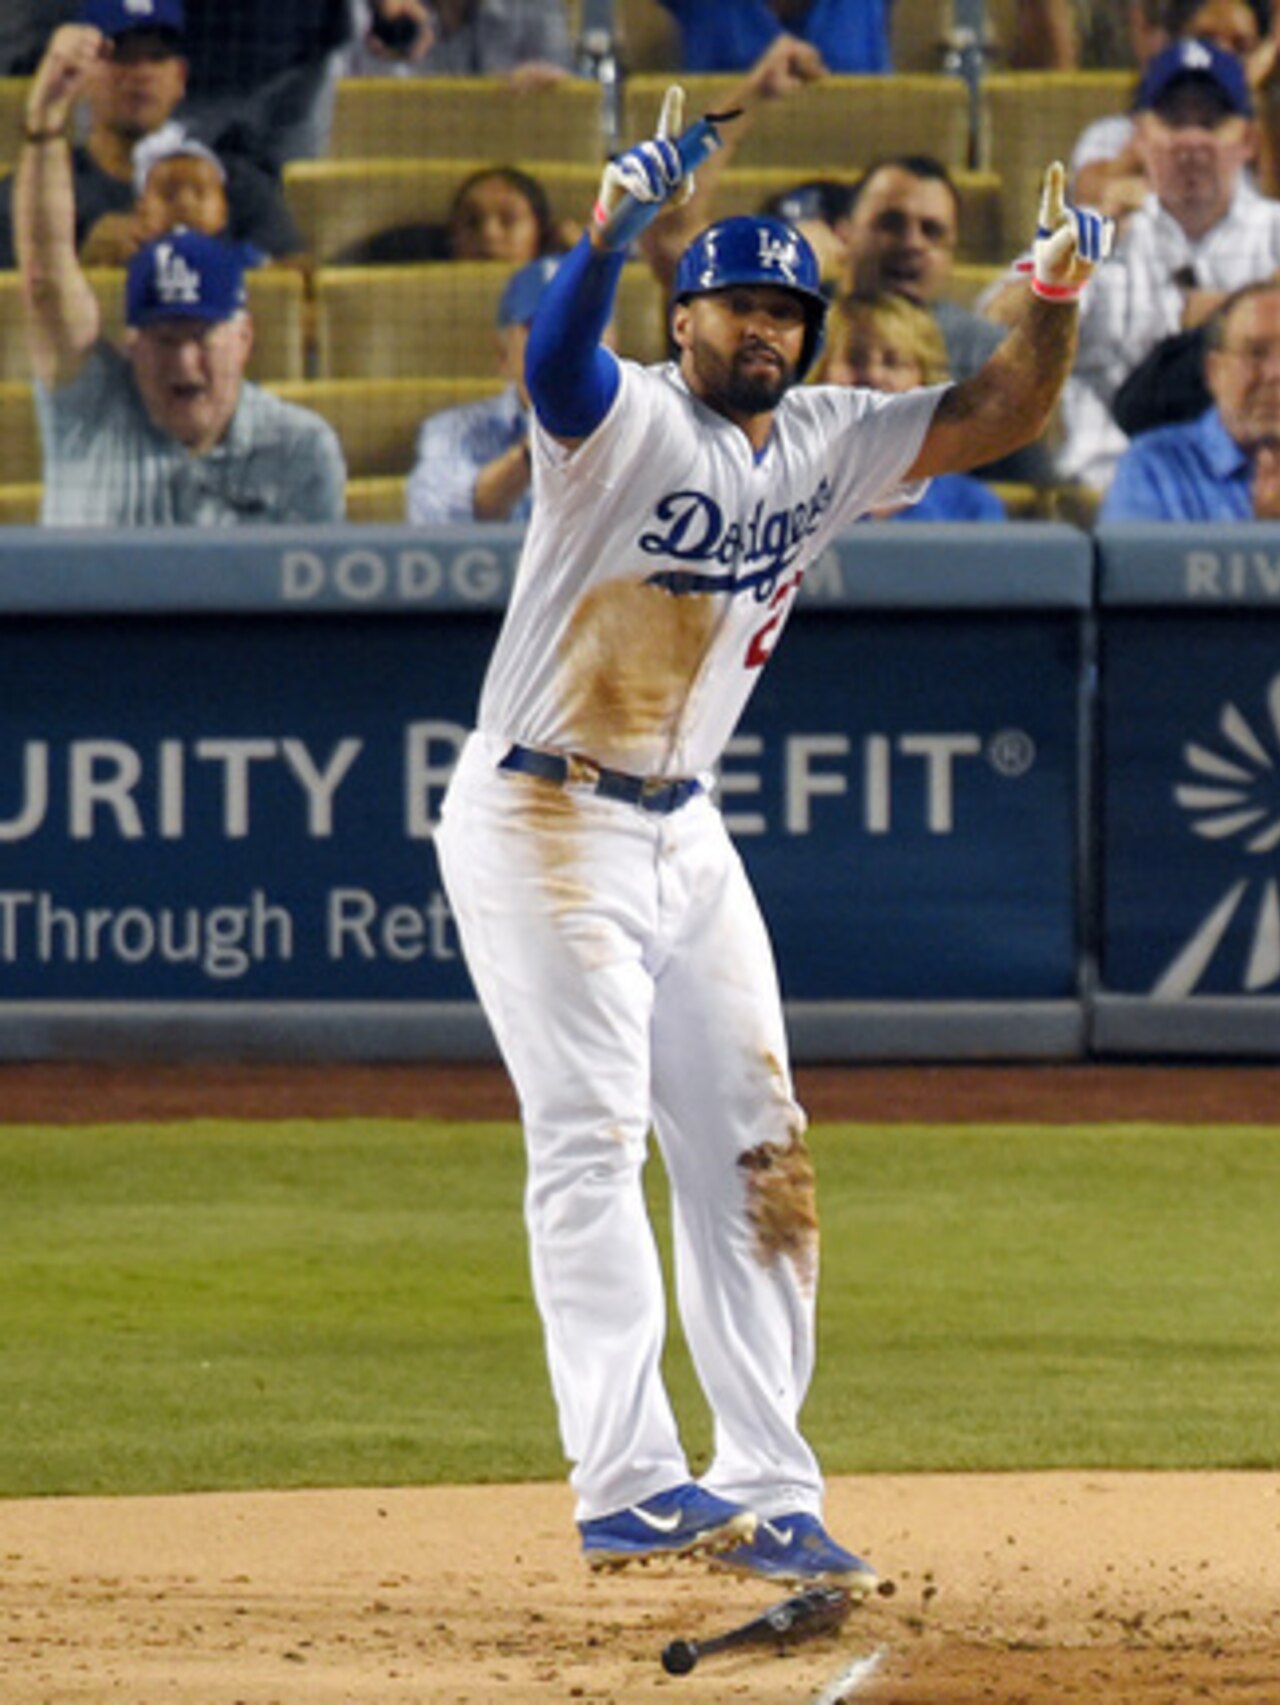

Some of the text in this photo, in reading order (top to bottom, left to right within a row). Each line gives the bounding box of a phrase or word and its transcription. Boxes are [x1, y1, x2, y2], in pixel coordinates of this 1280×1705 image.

[281, 550, 522, 600] DODG
[638, 475, 834, 603] Dodgers
[0, 888, 458, 979] Through Ret
